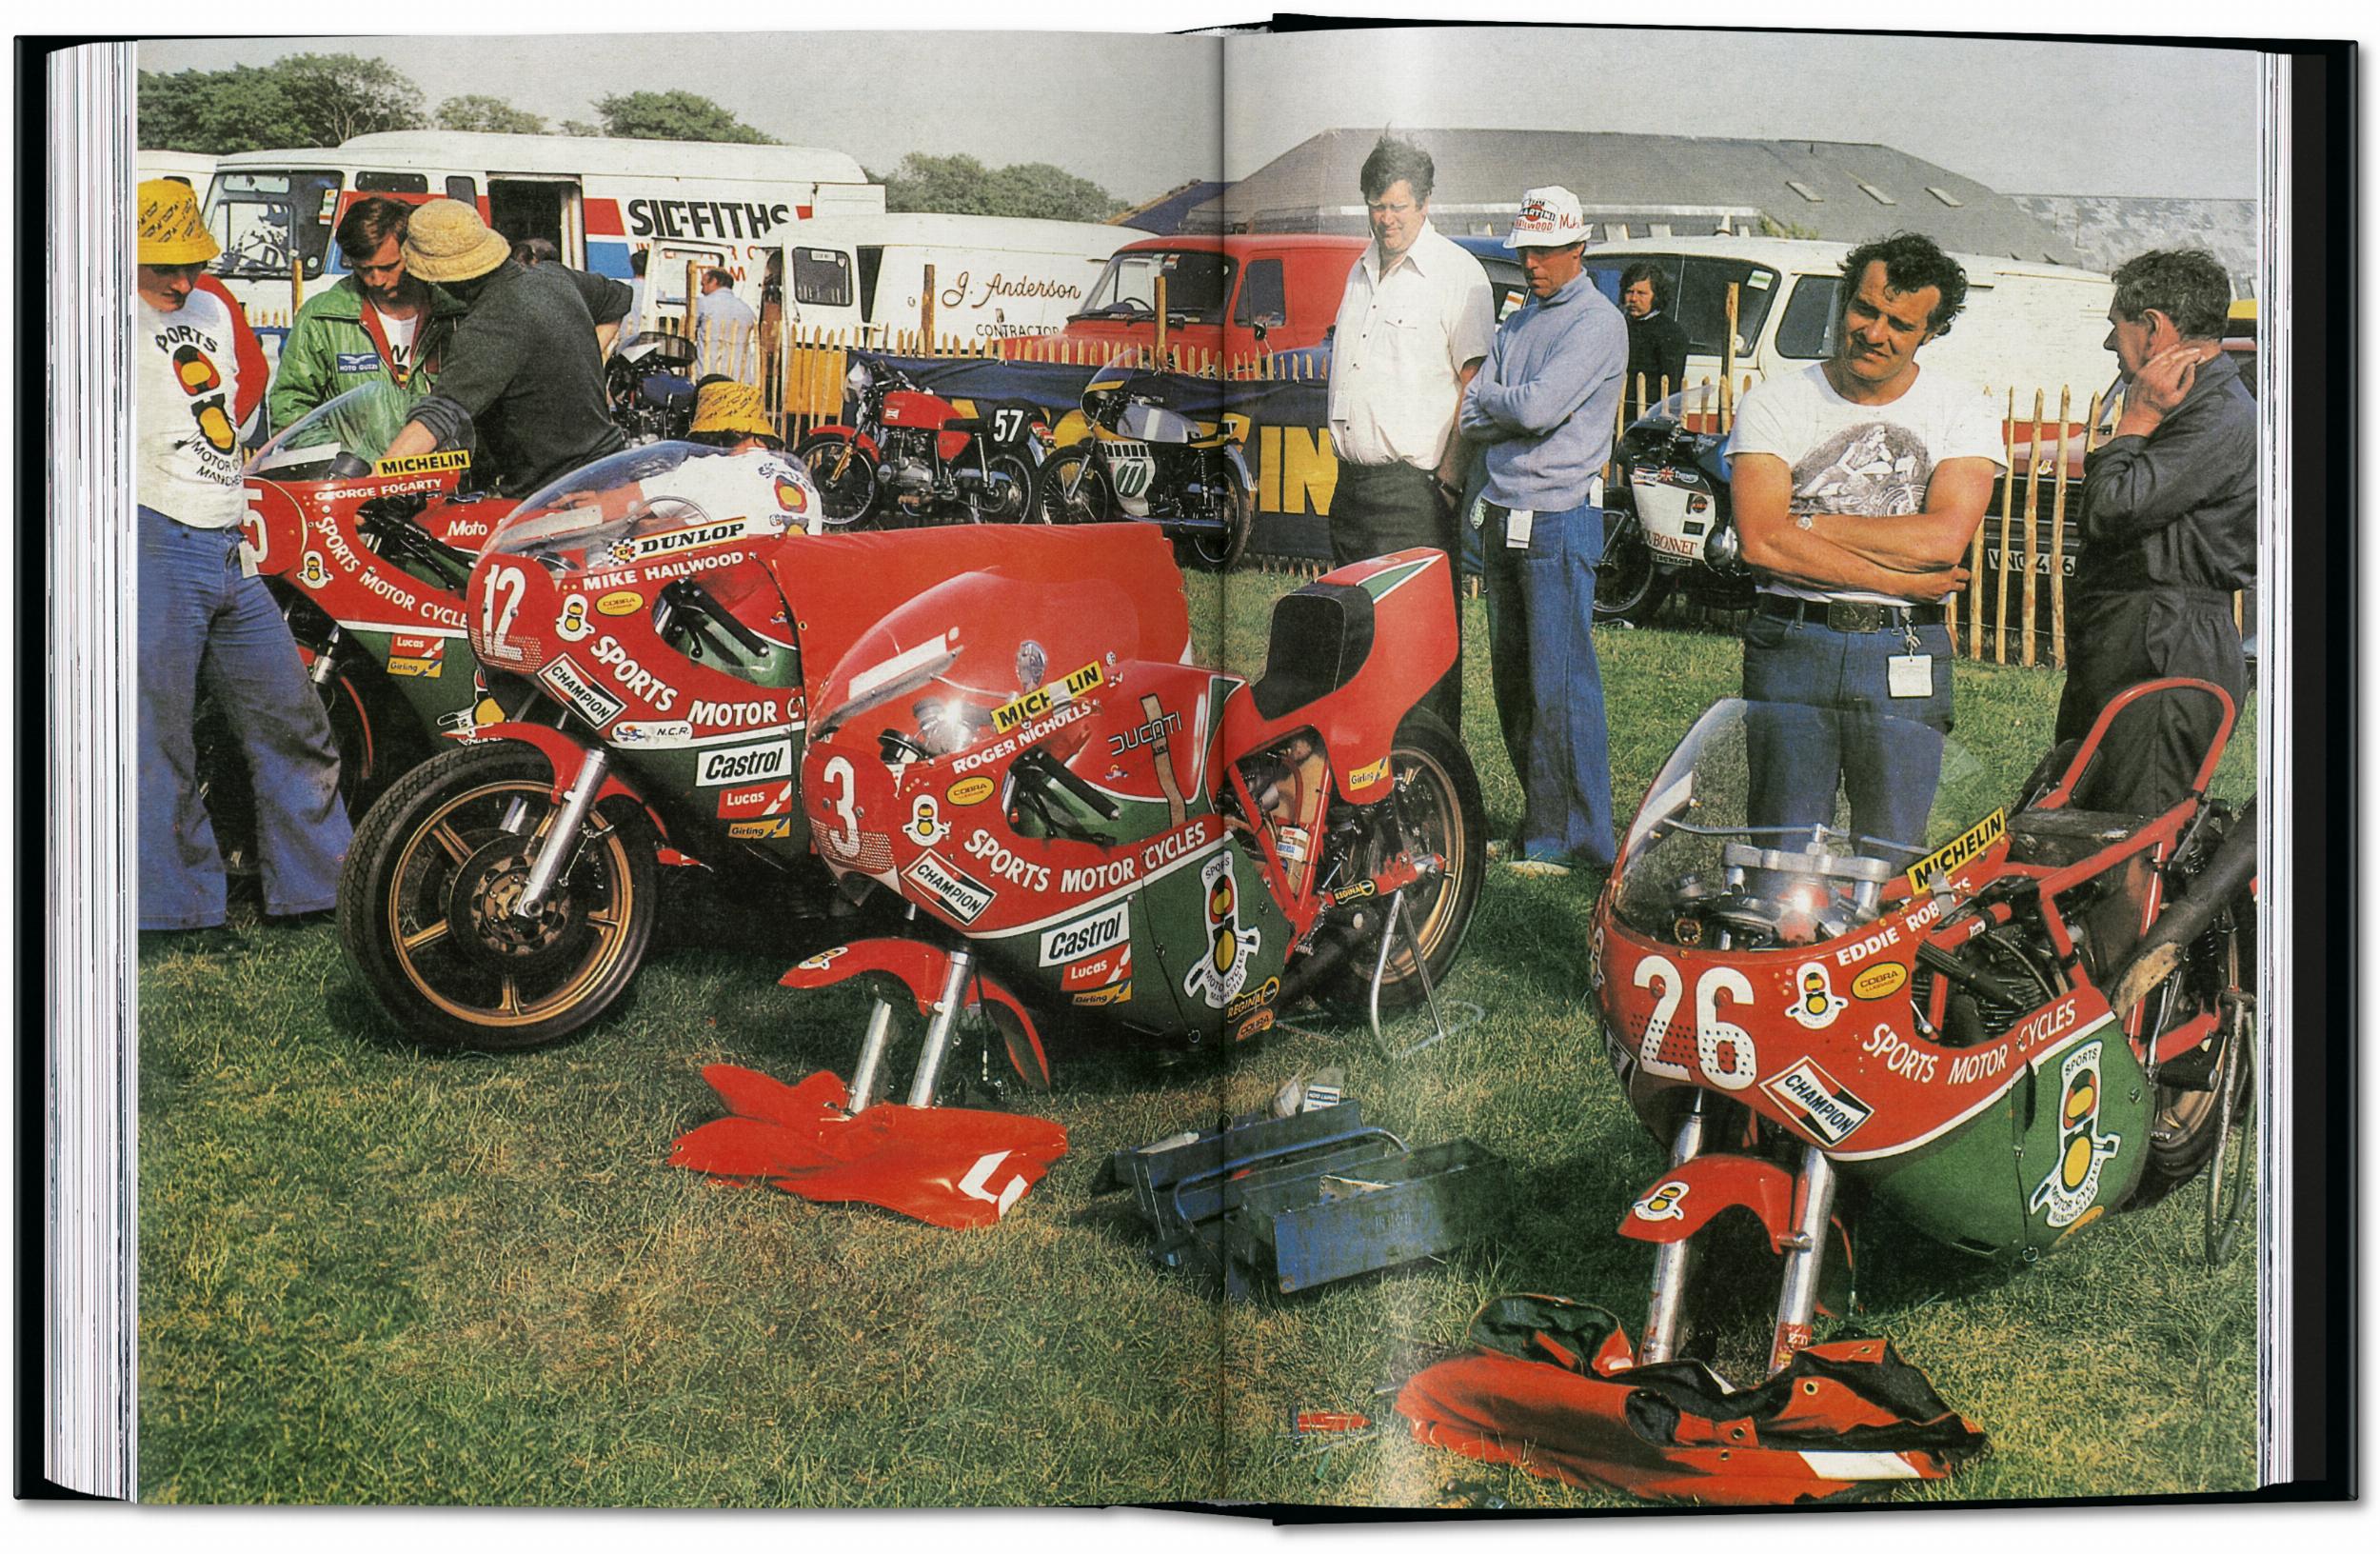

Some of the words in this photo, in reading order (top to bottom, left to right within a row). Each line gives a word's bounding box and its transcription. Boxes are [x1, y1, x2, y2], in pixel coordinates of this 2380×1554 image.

[971, 272, 1081, 309] Anderson
[993, 409, 1023, 443] 57
[190, 441, 231, 472] MOTOR
[381, 452, 467, 475] MICHELIN
[1259, 426, 1339, 516] IN
[314, 487, 376, 501] GEORGE
[381, 478, 442, 496] FOGARTY
[446, 520, 488, 537] Moto
[641, 523, 744, 554] DUNLOP
[315, 516, 362, 573] SPORTS
[358, 568, 416, 612] MOTOR
[582, 569, 639, 591] MIKE
[645, 551, 744, 581] HAILWOOD
[483, 564, 526, 662] 12
[396, 636, 426, 649] Lucas
[550, 665, 611, 719] CHAMPION
[589, 635, 679, 712] SPORTS
[686, 699, 778, 727] MOTOR
[656, 727, 690, 736] N.C.R.
[951, 738, 1018, 774] ROGER
[1017, 702, 1092, 747] NICHOLLS
[1107, 710, 1182, 756] DUCATI
[704, 747, 784, 780] Castrol
[726, 790, 765, 807] Lucas
[823, 755, 861, 858] 3
[731, 827, 764, 836] Girling
[1914, 813, 2002, 889] MICHELIN
[962, 828, 1052, 893] SPORTS
[1060, 857, 1136, 893] MOTOR
[1141, 821, 1206, 870] CYCLES
[916, 864, 982, 913] CHAMPION
[1048, 910, 1122, 960] Castrol
[1835, 926, 1900, 967] EDDIE
[1070, 959, 1108, 980] Lucas
[1859, 970, 1899, 988] COBRA
[1227, 991, 1262, 1019] REGINA
[1633, 954, 1758, 1091] 26
[1863, 1023, 1939, 1084] SPORTS
[1947, 1044, 2007, 1086] MOTOR
[2016, 998, 2077, 1052] CYCLES
[2065, 1047, 2098, 1077] SPORTS
[1784, 1074, 1855, 1134] CHAMPION
